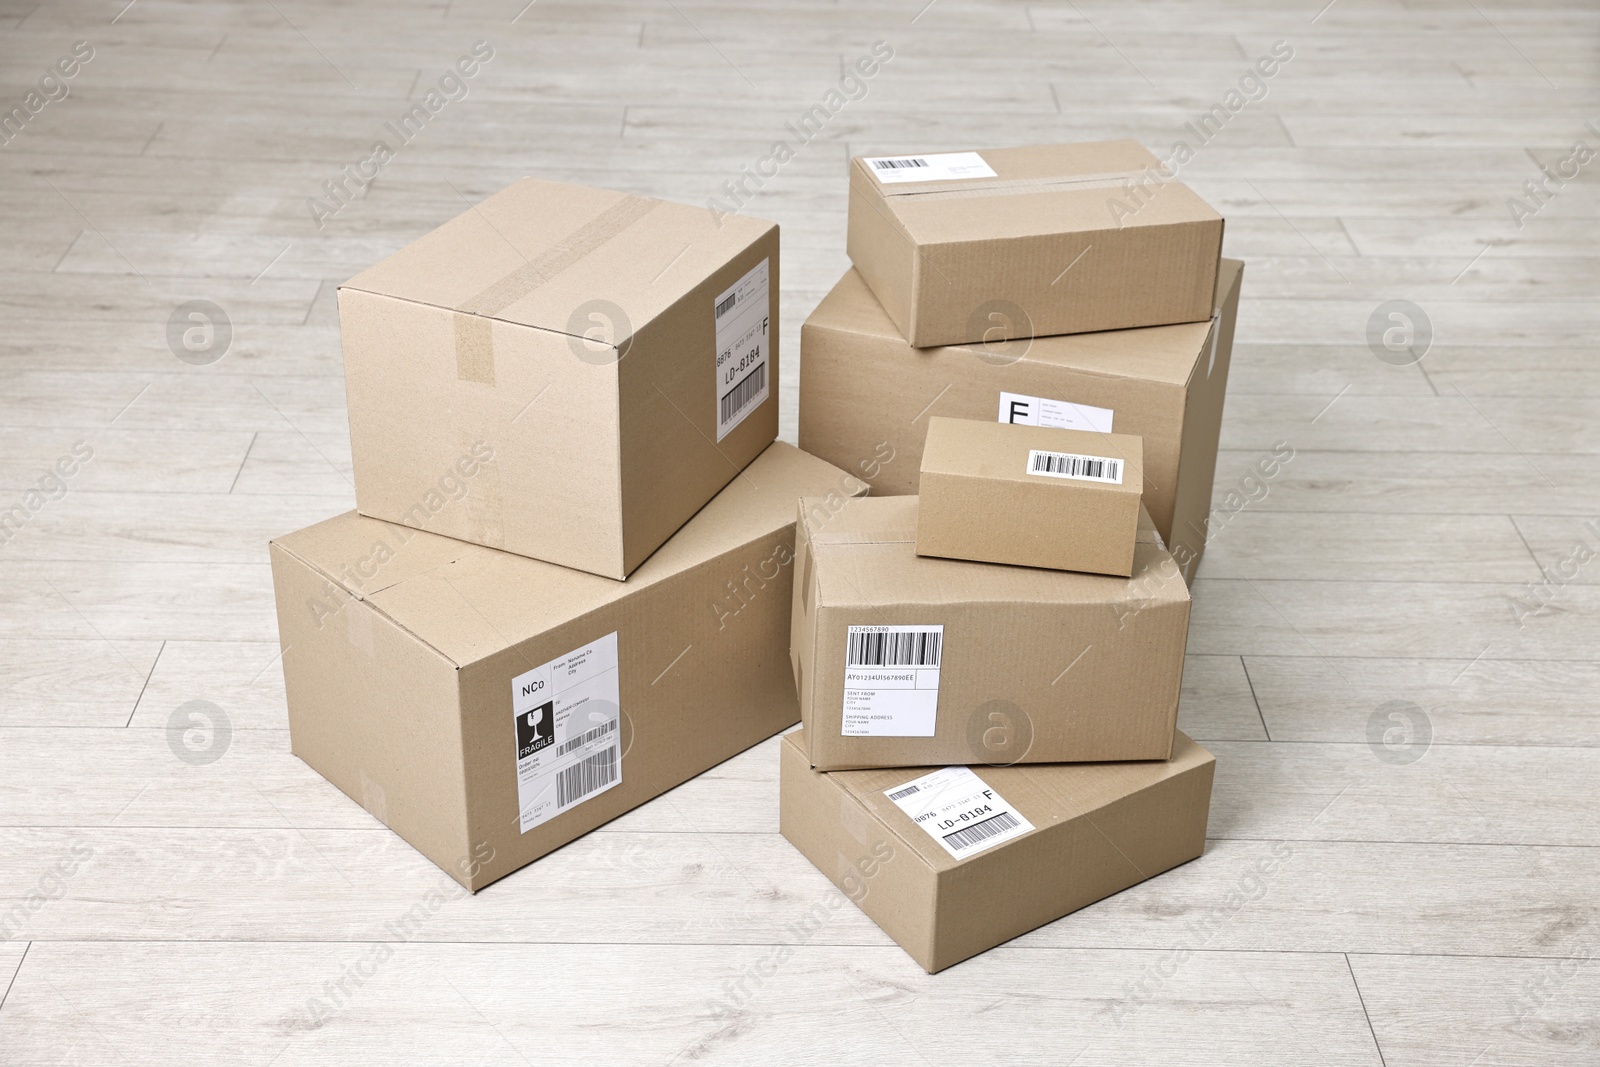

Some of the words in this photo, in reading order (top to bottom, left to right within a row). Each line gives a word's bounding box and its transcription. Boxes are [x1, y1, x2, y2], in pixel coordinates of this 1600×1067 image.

[762, 316, 769, 336] F
[725, 344, 760, 385] LD-0104
[1009, 401, 1029, 424] F
[567, 653, 586, 663] Noname
[568, 658, 586, 670] Address
[568, 668, 577, 676] City
[555, 705, 572, 716] ANOTHER
[572, 697, 590, 708] COMPANY
[519, 735, 553, 758] FRAGILE
[519, 759, 532, 770] Order
[982, 789, 993, 800] F
[937, 804, 993, 830] LD-0104
